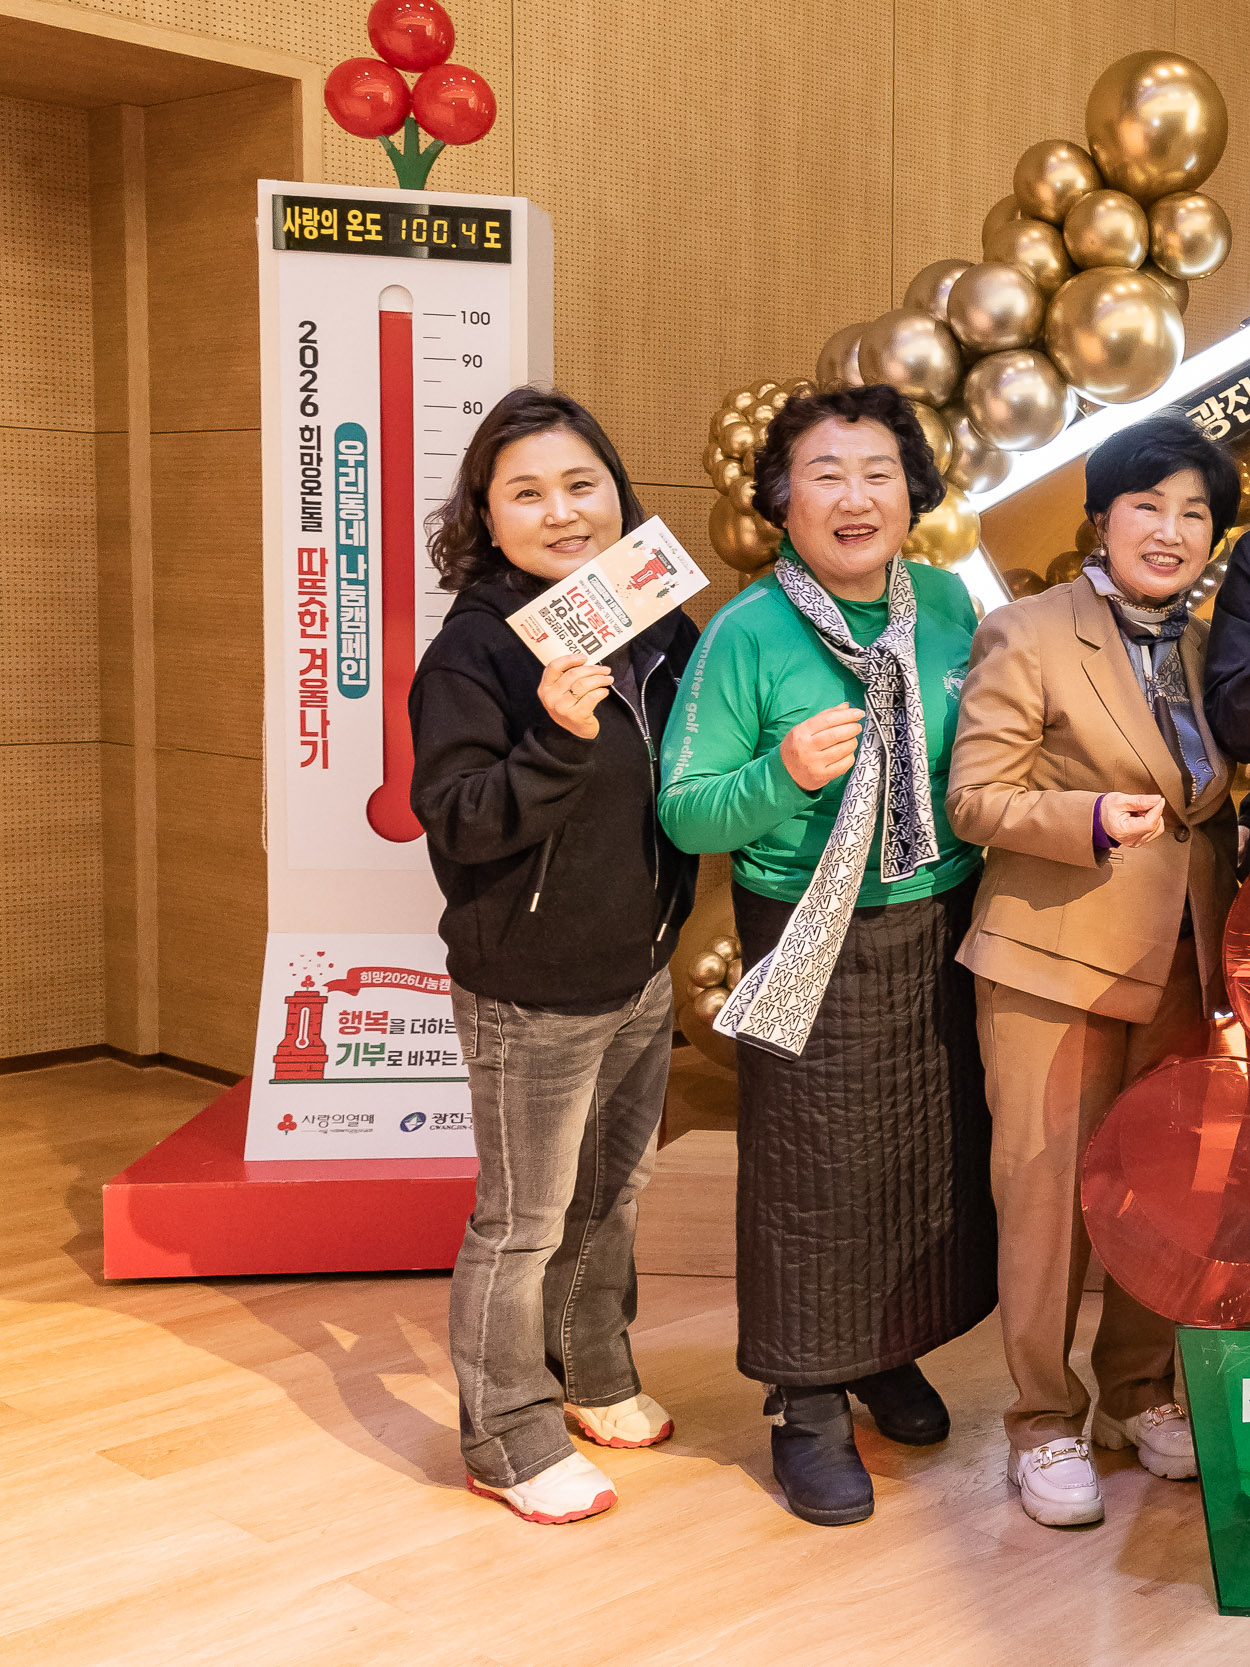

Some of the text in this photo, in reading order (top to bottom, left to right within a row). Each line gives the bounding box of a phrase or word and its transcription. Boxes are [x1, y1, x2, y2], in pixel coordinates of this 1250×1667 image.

[282, 206, 338, 241] 사랑의
[346, 210, 383, 242] 온도
[460, 311, 491, 326] 100
[462, 354, 483, 368] 90
[463, 401, 483, 415] 80
[298, 320, 331, 770] 2026 희망온돌 따뜻한 겨울나기
[337, 440, 368, 686] 우리동네 나눔캠페인
[549, 594, 603, 656] 따뜻한
[566, 585, 616, 643] 겨울나기
[685, 702, 700, 734] golf
[338, 1010, 457, 1035] 행복을 더하는
[335, 1042, 457, 1067] 기부로 바꾸는
